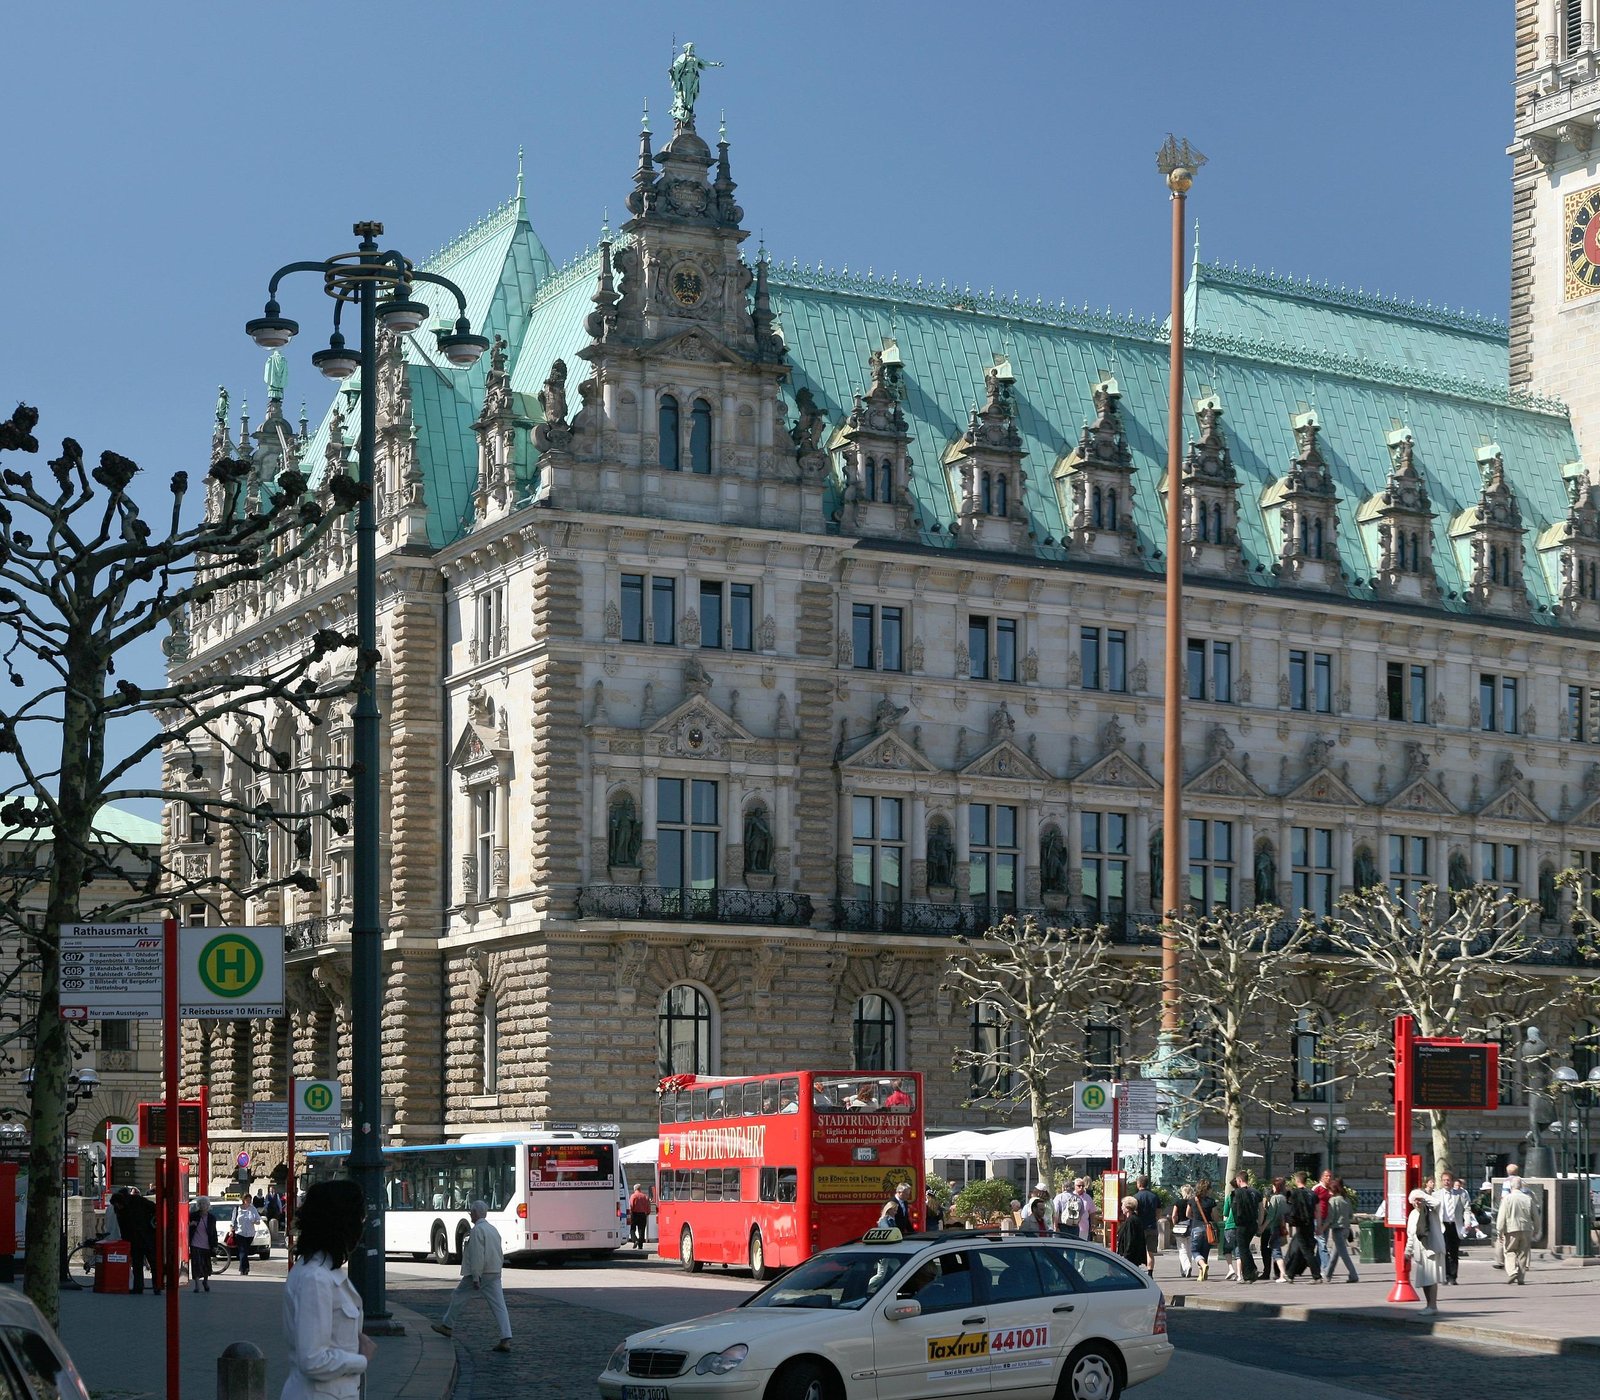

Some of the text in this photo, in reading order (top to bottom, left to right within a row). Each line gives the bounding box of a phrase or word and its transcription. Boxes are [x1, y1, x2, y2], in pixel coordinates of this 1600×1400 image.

[73, 926, 149, 936] Rathausmarkt
[64, 953, 82, 961] 607
[65, 967, 82, 975] 608
[216, 949, 246, 983] H
[71, 1009, 77, 1017] 3
[188, 1007, 234, 1015] Reisebusse
[236, 1007, 246, 1015] 10
[247, 1007, 266, 1015] Min.
[266, 1007, 282, 1015] Frei
[311, 1090, 325, 1106] H
[1088, 1090, 1099, 1105] H
[818, 1114, 913, 1127] STADTRUNDFAHRT
[121, 1130, 130, 1140] H
[826, 1128, 847, 1136] täglich
[858, 1128, 904, 1136] Hauptbahnhof
[687, 1125, 766, 1161] STADTRUNDFAHRT
[840, 1137, 893, 1145] Landungsbrücke
[546, 1146, 551, 1156] 3
[867, 1230, 890, 1239] TAXI
[928, 1327, 1047, 1359] Taxiruf 441011
